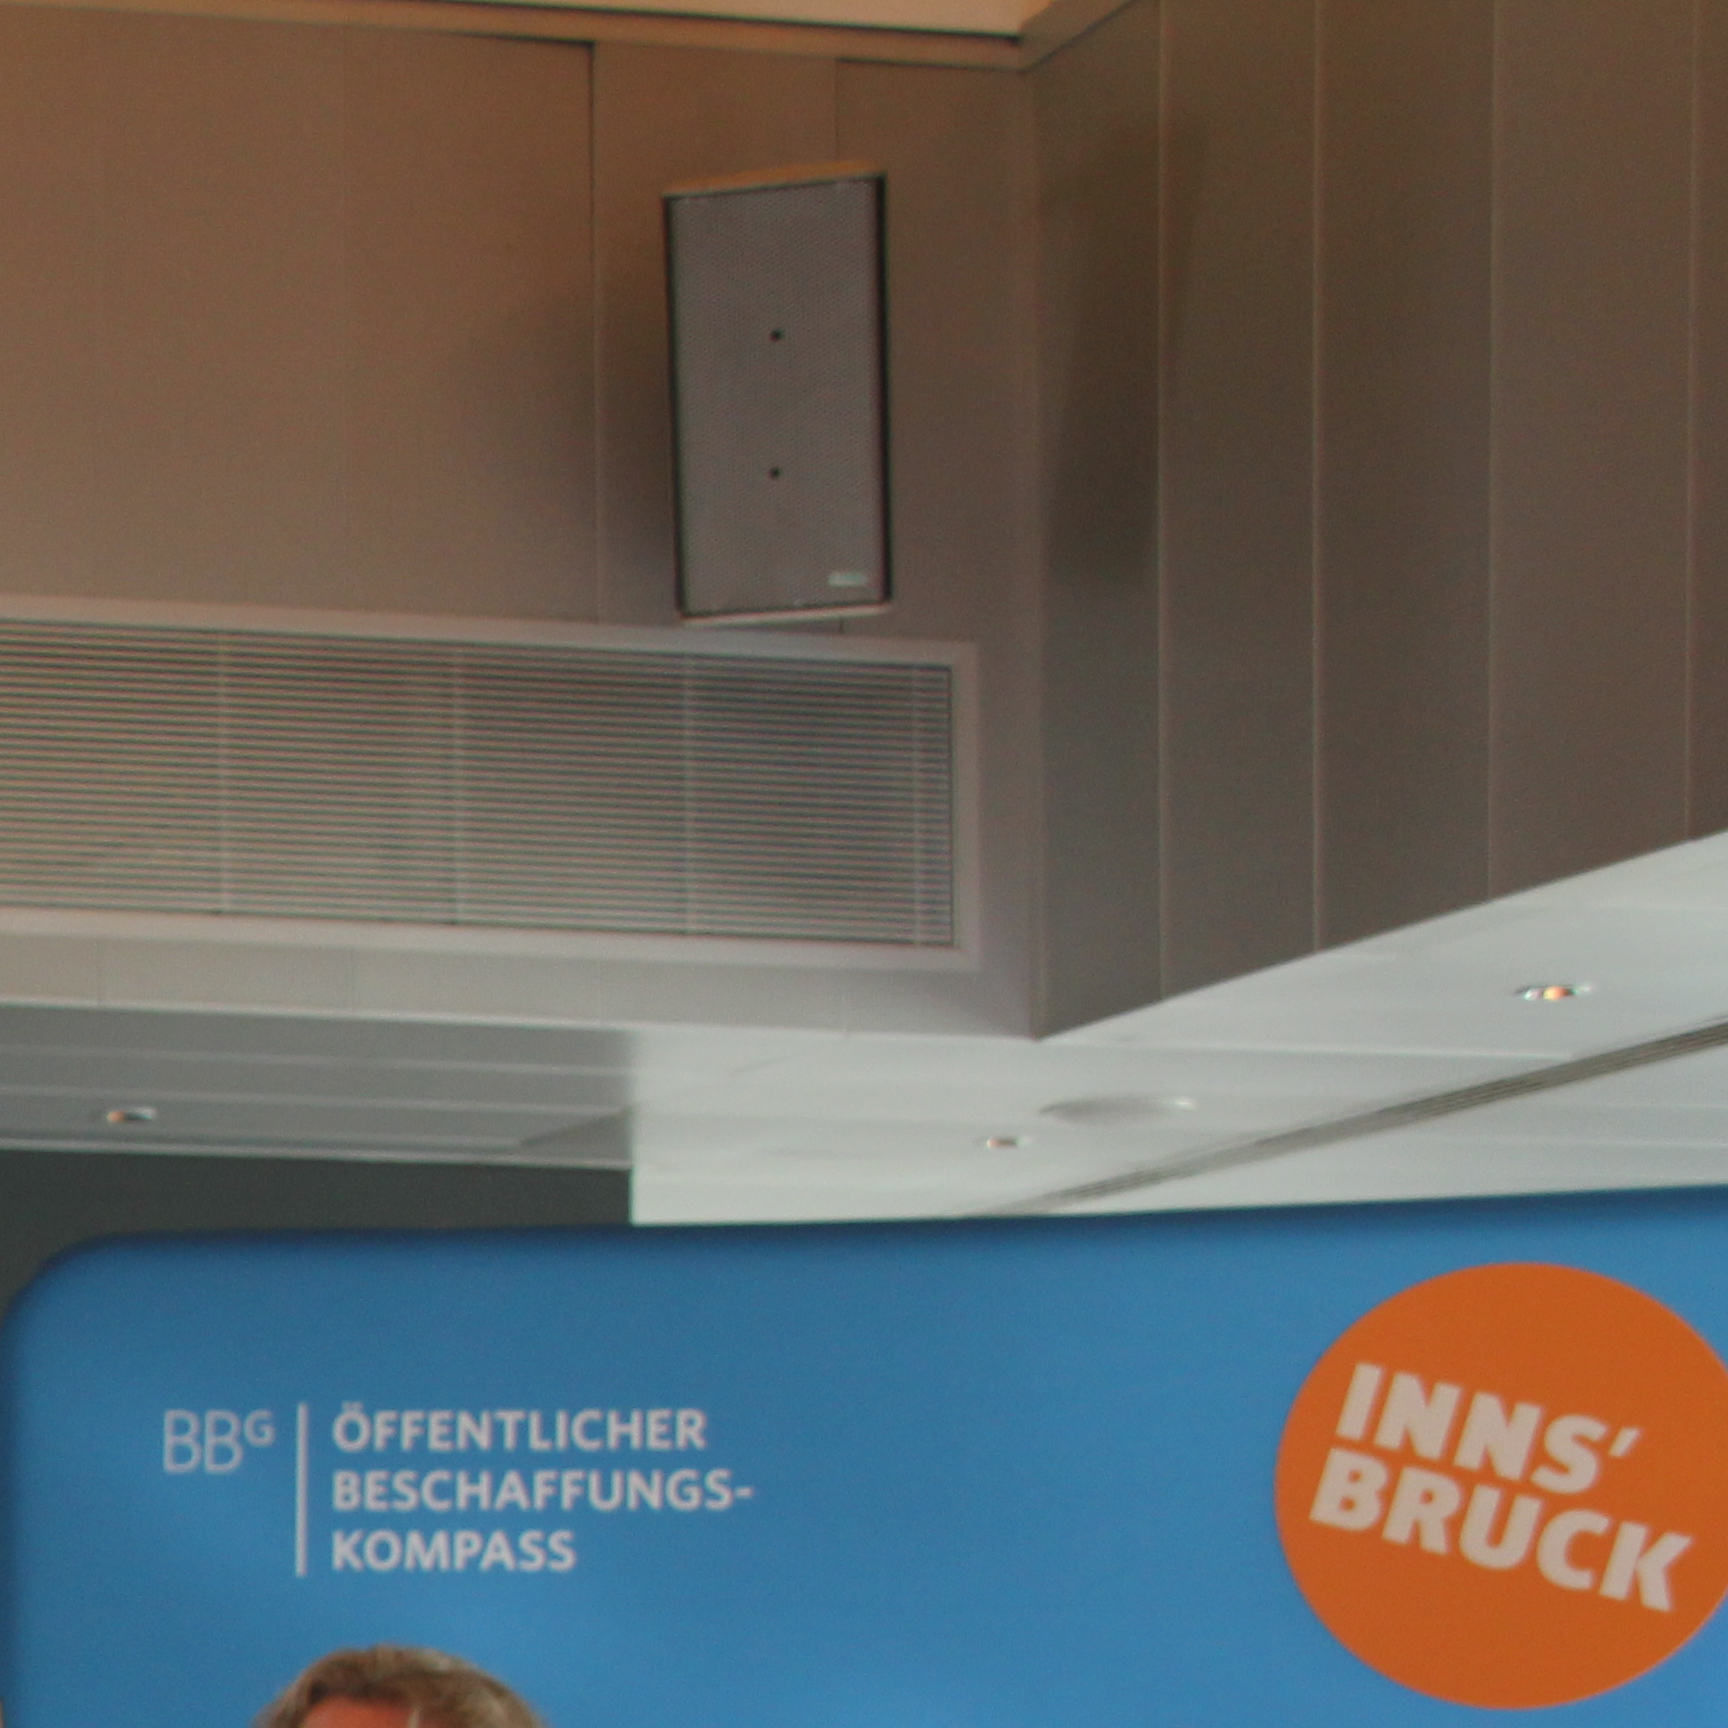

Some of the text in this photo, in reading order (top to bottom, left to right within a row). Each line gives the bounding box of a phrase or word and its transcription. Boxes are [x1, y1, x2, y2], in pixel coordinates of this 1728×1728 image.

[334, 1404, 705, 1451] ÖFFENTLICHER
[335, 1470, 751, 1510] BESCHAFFUNGS-
[334, 1531, 575, 1570] KOMPASS
[1310, 1449, 1692, 1612] BRUCK
